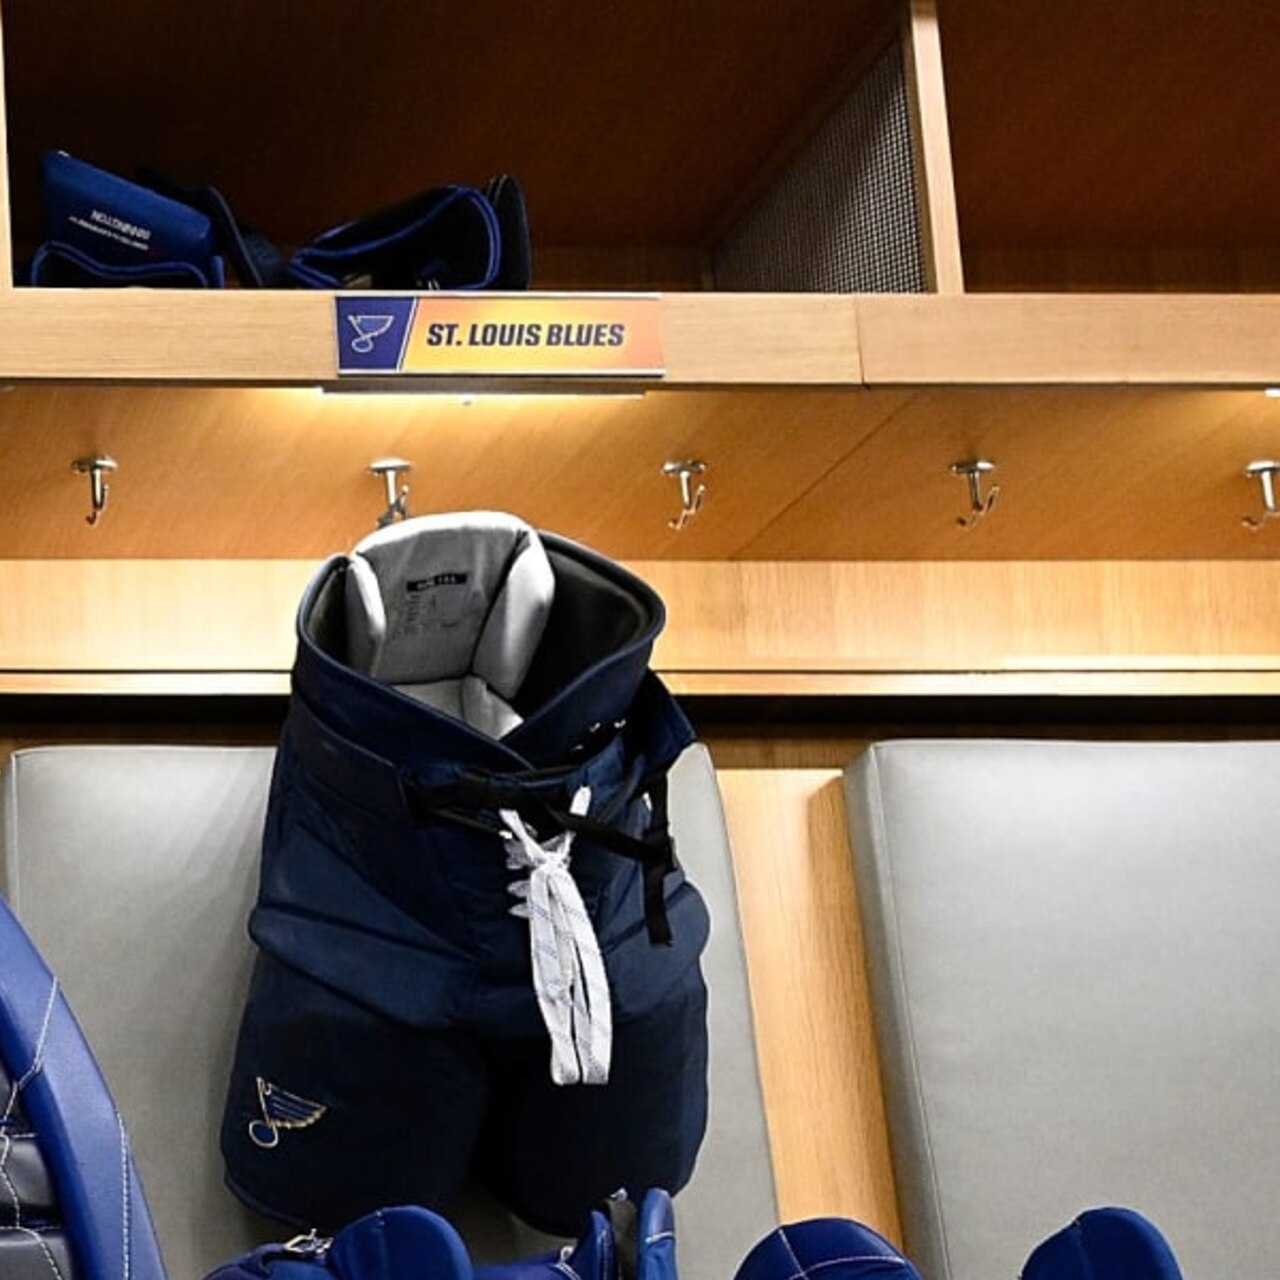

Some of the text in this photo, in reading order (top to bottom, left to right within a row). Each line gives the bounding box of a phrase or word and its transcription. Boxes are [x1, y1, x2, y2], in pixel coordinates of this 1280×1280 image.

[427, 323, 625, 347] ST. LOUIS BLUES
